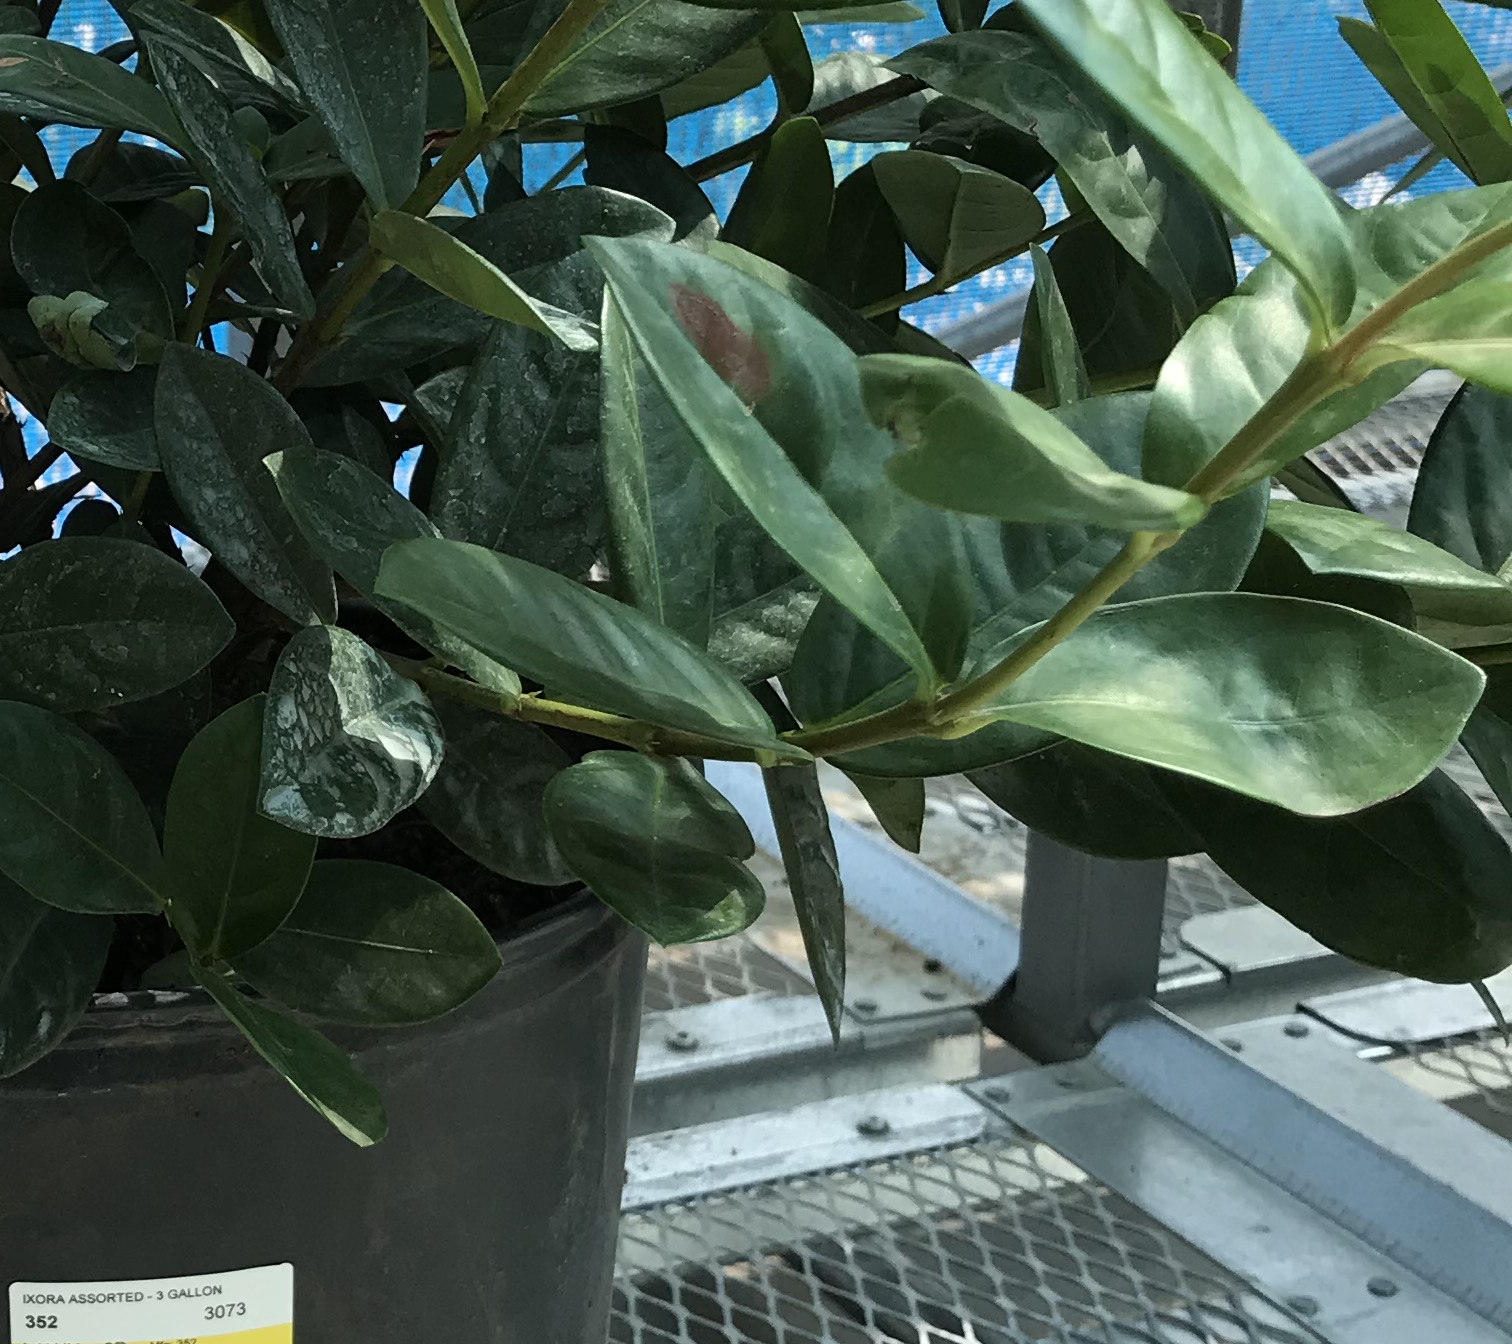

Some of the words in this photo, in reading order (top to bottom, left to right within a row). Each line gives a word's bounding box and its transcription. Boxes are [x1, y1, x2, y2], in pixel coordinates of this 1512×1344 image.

[23, 1294, 65, 1305] IXORA
[69, 1291, 144, 1304] ASSORTED
[156, 1291, 164, 1301] 3
[168, 1285, 223, 1300] GALLON
[25, 1315, 58, 1329] 352
[204, 1302, 246, 1320] 3073
